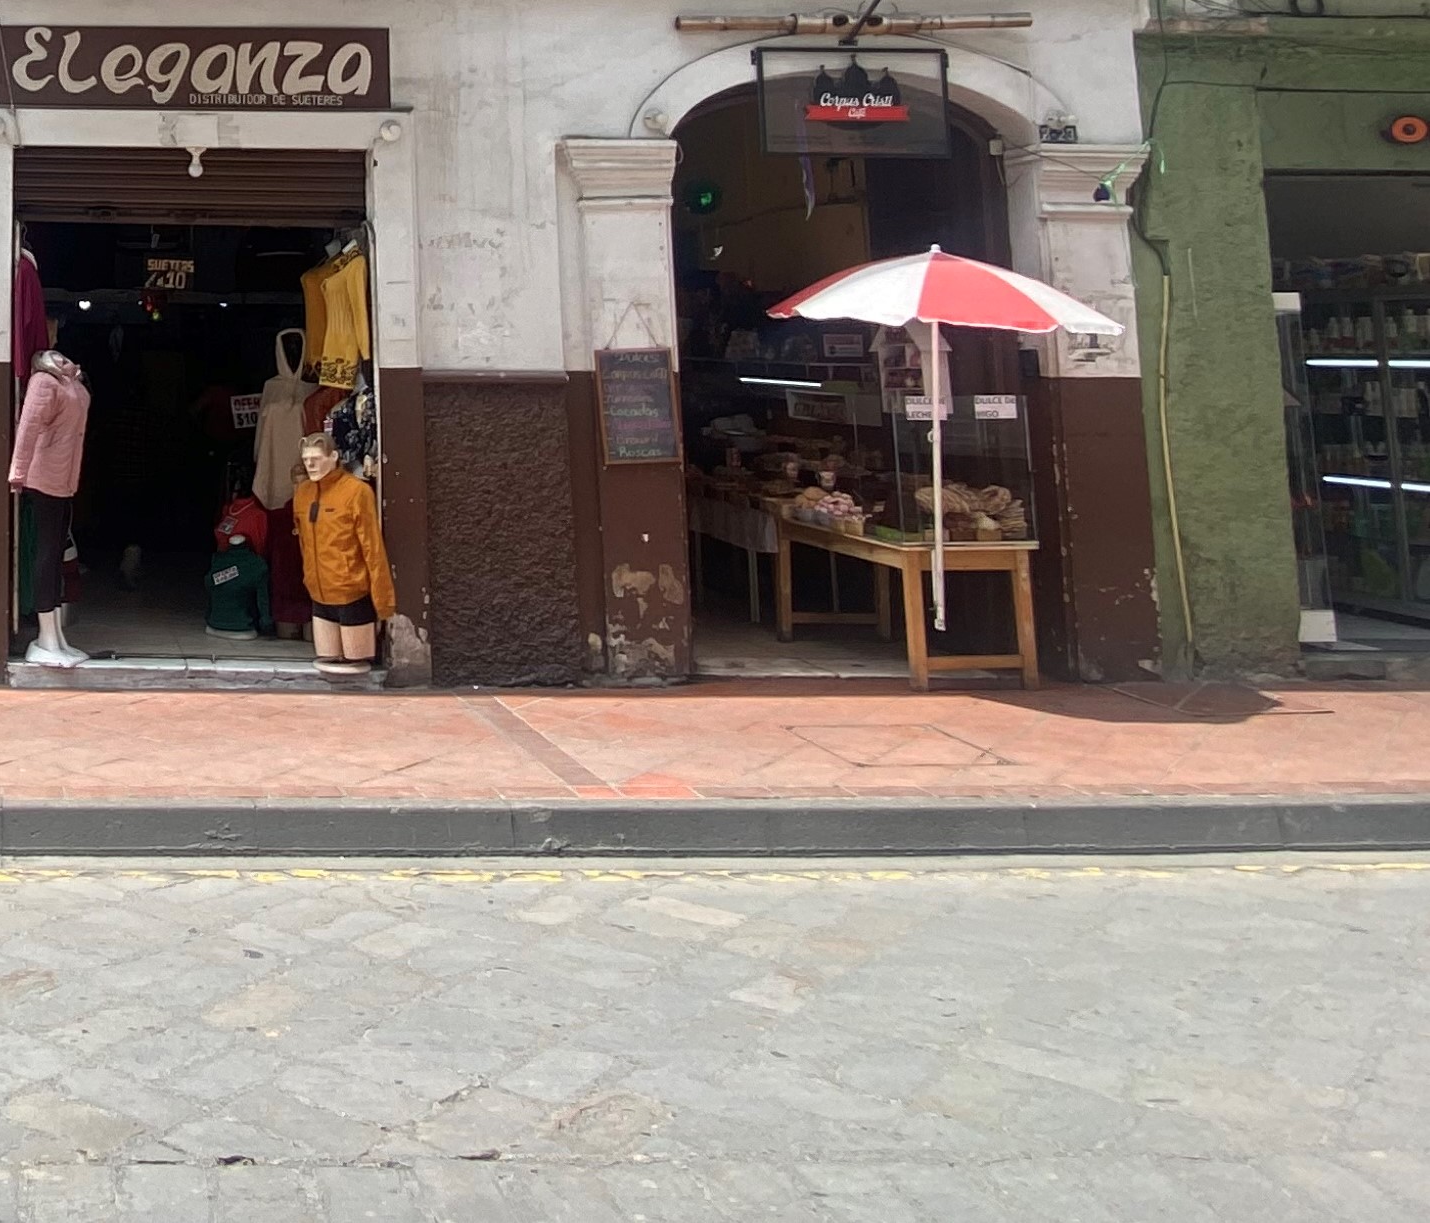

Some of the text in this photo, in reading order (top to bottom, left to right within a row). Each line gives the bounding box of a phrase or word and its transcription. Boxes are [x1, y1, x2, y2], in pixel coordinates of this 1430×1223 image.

[189, 92, 344, 106] DISTRIBUIDOR DE SUETERES
[820, 92, 859, 111] Corpus
[975, 396, 1003, 405] DULCE
